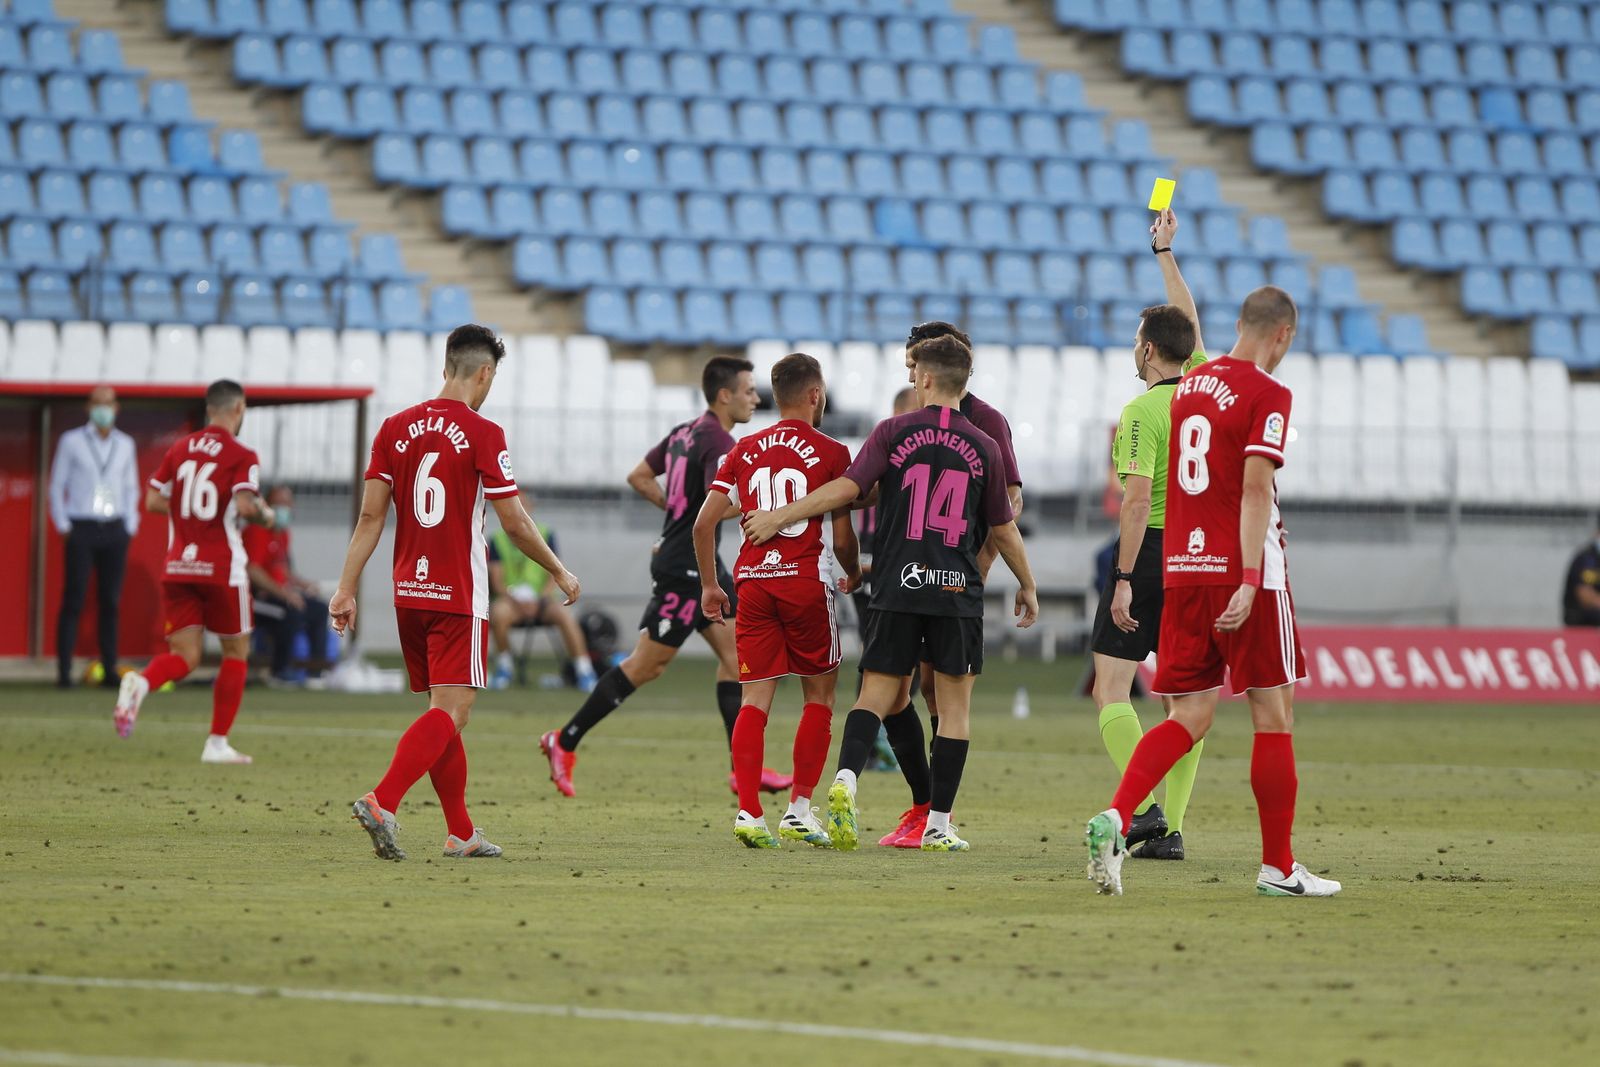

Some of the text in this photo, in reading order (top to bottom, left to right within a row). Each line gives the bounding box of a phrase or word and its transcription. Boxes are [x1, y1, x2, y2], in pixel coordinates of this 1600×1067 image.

[1176, 375, 1239, 411] PETROVIĆ
[188, 437, 223, 457] LAZO
[395, 416, 470, 454] G. DE LA HOZ
[742, 431, 821, 469] F. VILLALBA
[1178, 414, 1212, 495] 8
[176, 459, 219, 521] 16
[413, 452, 446, 528] 6
[748, 466, 809, 538] 10
[900, 463, 970, 548] 14
[925, 568, 966, 588] INTEGRA
[659, 592, 697, 625] 24
